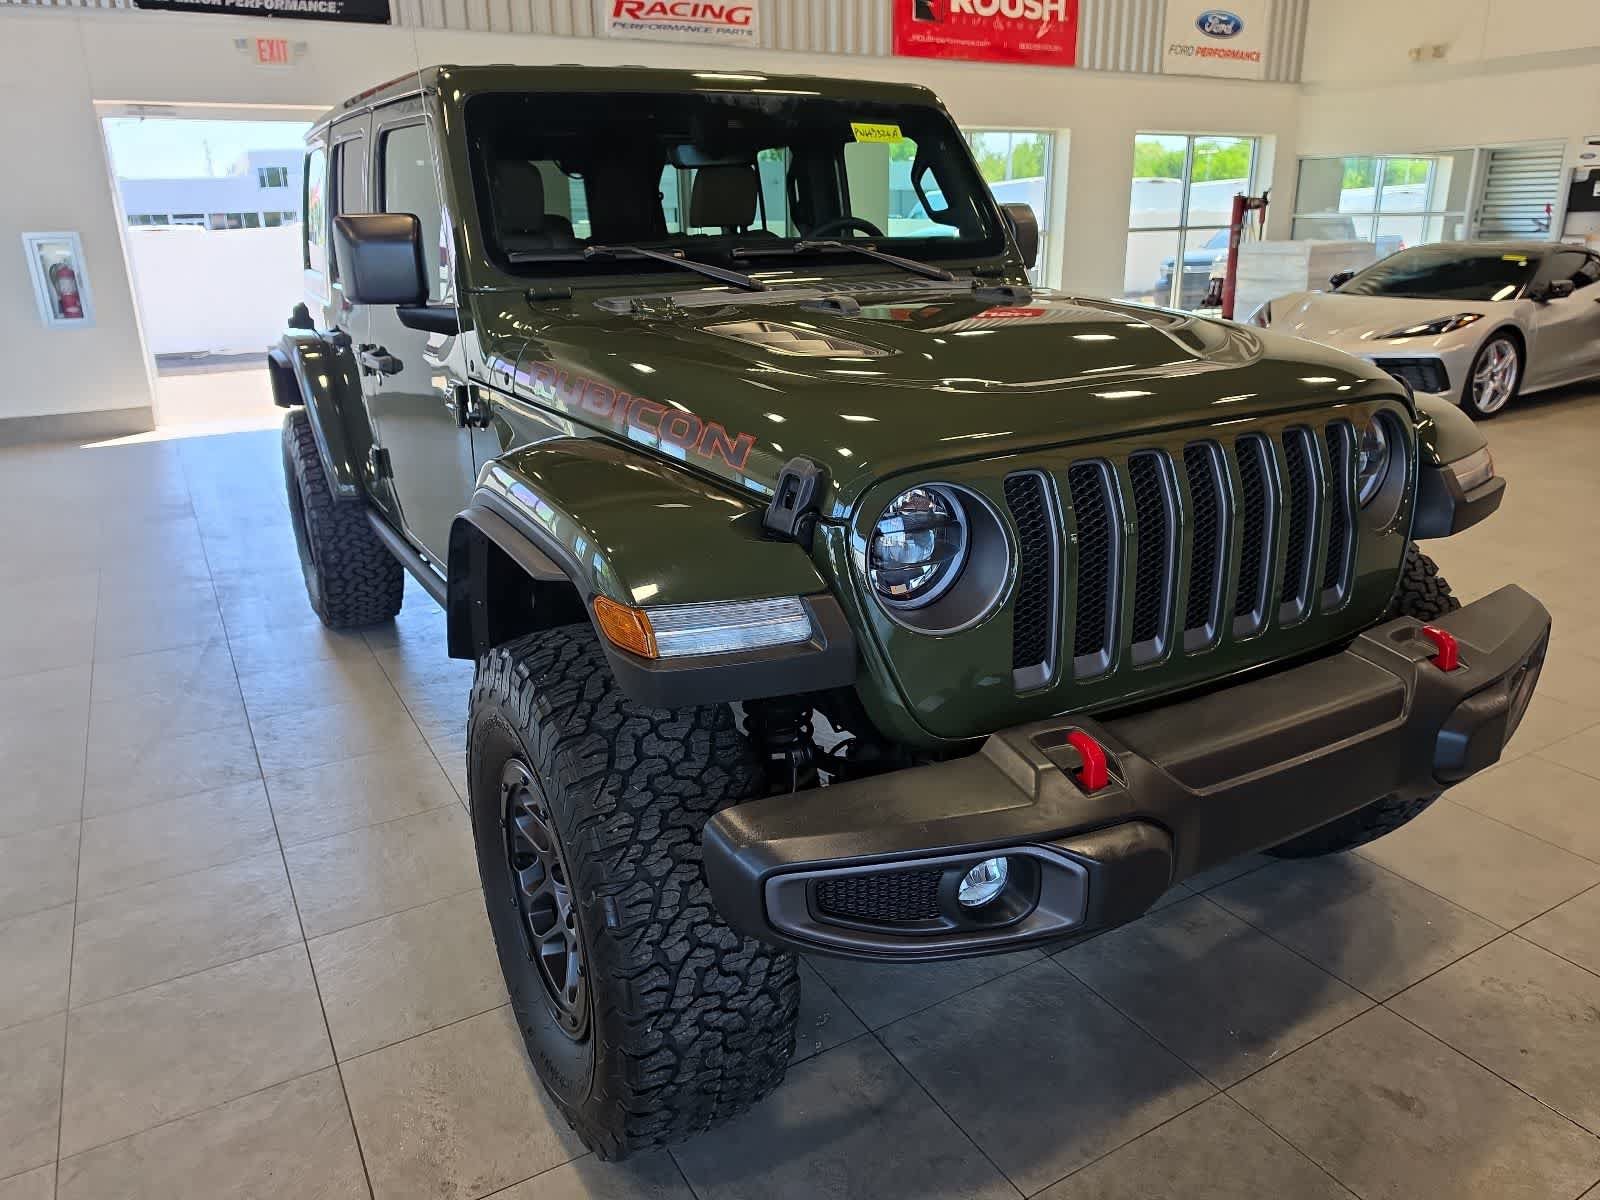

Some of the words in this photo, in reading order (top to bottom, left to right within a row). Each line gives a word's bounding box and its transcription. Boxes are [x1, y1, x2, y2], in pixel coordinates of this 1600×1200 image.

[613, 0, 752, 25] RACING
[612, 22, 713, 33] PERFORMANCE
[716, 27, 753, 36] PARTS
[1204, 14, 1236, 35] Ford
[257, 39, 288, 63] EXIT
[1168, 44, 1195, 57] FORD
[1195, 46, 1261, 62] PERFORMANCE
[528, 360, 757, 470] RUBICON
